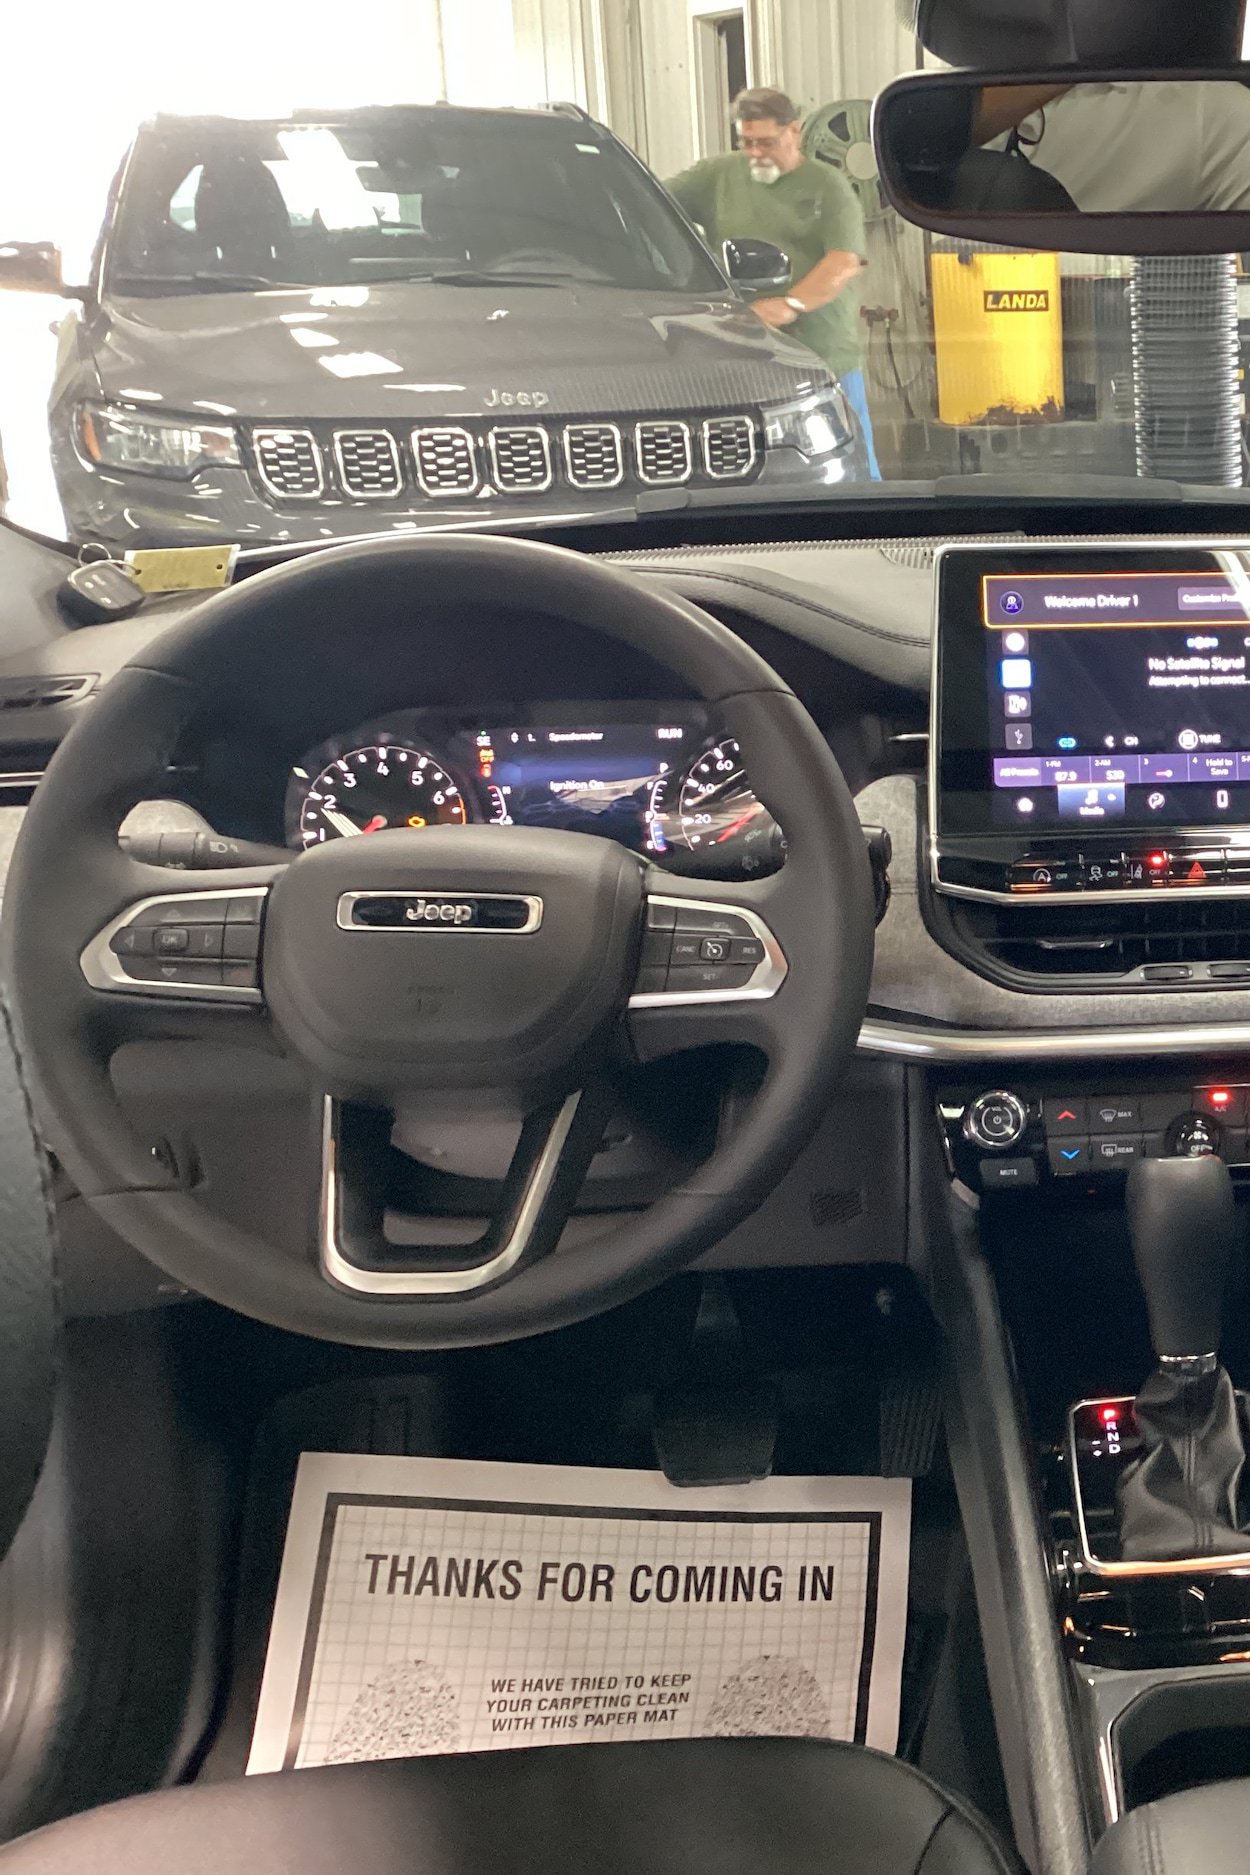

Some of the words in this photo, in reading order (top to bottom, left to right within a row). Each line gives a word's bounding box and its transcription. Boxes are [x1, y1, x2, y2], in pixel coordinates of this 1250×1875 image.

[986, 293, 1047, 309] LANDA
[483, 388, 549, 408] Jeep
[1044, 594, 1096, 609] Welcome
[1097, 593, 1131, 608] Driver
[1132, 594, 1139, 607] 1
[1148, 657, 1166, 671] No
[1167, 656, 1210, 670] Satellite
[1211, 656, 1245, 671] Signal
[1149, 675, 1199, 688] Attempting
[1199, 675, 1210, 685] to
[1198, 733, 1221, 744] TUNE
[377, 761, 390, 776] 4
[716, 760, 734, 771] 60
[1206, 757, 1222, 767] Hold
[343, 772, 357, 788] 3
[411, 770, 424, 786] 5
[550, 781, 587, 793] Ignition
[698, 783, 715, 794] 40
[323, 794, 337, 809] 2
[433, 790, 445, 805] 6
[694, 813, 712, 825] 20
[319, 827, 326, 842] 1
[406, 899, 472, 924] Jeep
[1117, 1146, 1134, 1154] REAR
[1000, 1168, 1018, 1176] MUTE
[1103, 1409, 1116, 1419] P
[1106, 1421, 1118, 1431] R
[1107, 1431, 1120, 1442] N
[1108, 1443, 1121, 1454] D
[365, 1554, 523, 1601] THANKS
[537, 1562, 615, 1603] FOR
[630, 1564, 783, 1603] COMING
[798, 1565, 835, 1602] IN
[491, 1679, 515, 1693] WE
[521, 1678, 565, 1693] HAVE
[571, 1676, 618, 1691] TRIED
[624, 1675, 645, 1689] TO
[650, 1673, 692, 1688] KEEP
[486, 1699, 532, 1713] YOUR
[537, 1695, 631, 1711] CARPETING
[636, 1692, 690, 1706] CLEAN
[492, 1717, 535, 1732] WITH
[542, 1714, 578, 1729] THIS
[583, 1711, 637, 1727] PAPER
[643, 1708, 679, 1723] MAT
